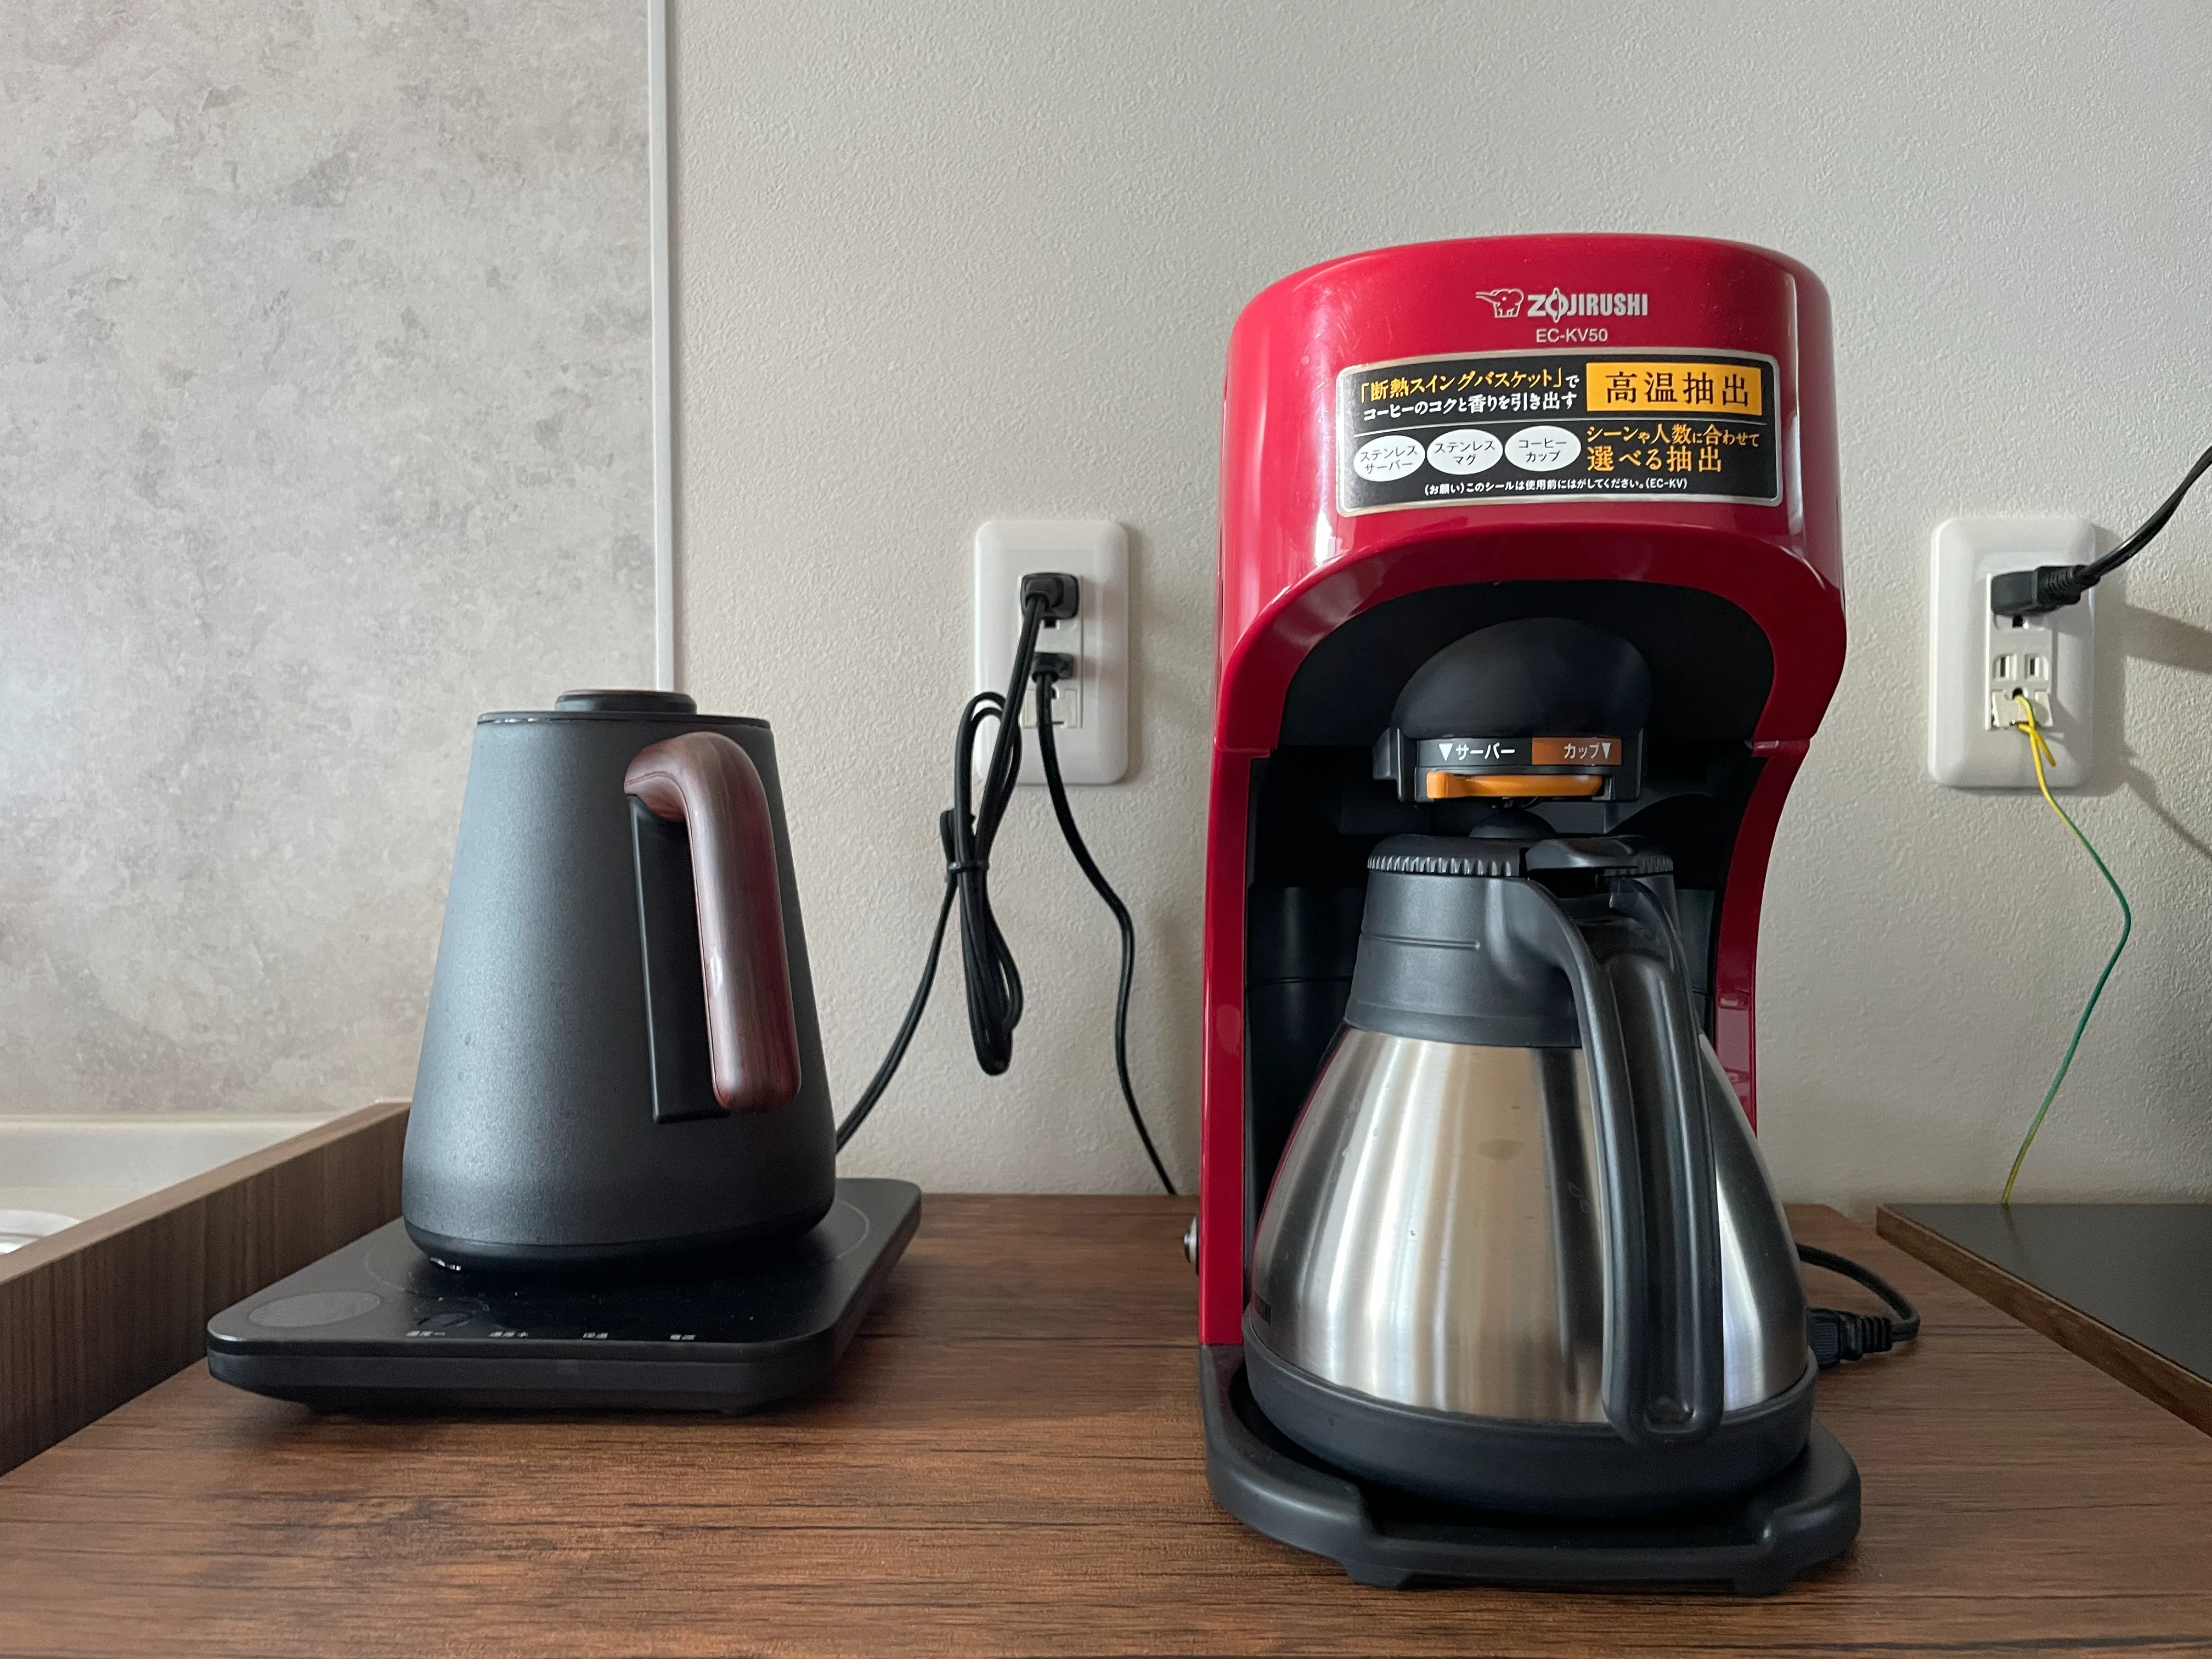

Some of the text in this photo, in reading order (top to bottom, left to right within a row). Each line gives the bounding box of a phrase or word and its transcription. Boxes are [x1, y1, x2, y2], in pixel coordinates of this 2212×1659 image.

[1527, 287, 1648, 323] ZOJIRUSHI
[1536, 328, 1609, 343] EC-KV50
[1361, 367, 1580, 403] 「断熱スイングバスケット」で
[1605, 371, 1750, 407] 高温抽出
[1363, 391, 1577, 421] コーヒーのコクと香りを引き出す
[1518, 438, 1567, 449] コーヒー
[1587, 423, 1760, 448] シーンや人数に合わせて
[1360, 445, 1418, 462] ステンレス
[1434, 440, 1496, 454] ステンレス
[1453, 453, 1477, 466] マグ
[1525, 450, 1561, 463] カップ
[1587, 445, 1723, 473] 選べる抽出
[1364, 460, 1413, 475] サーバー
[1455, 742, 1515, 760] サーバー
[1564, 742, 1600, 760] カップ
